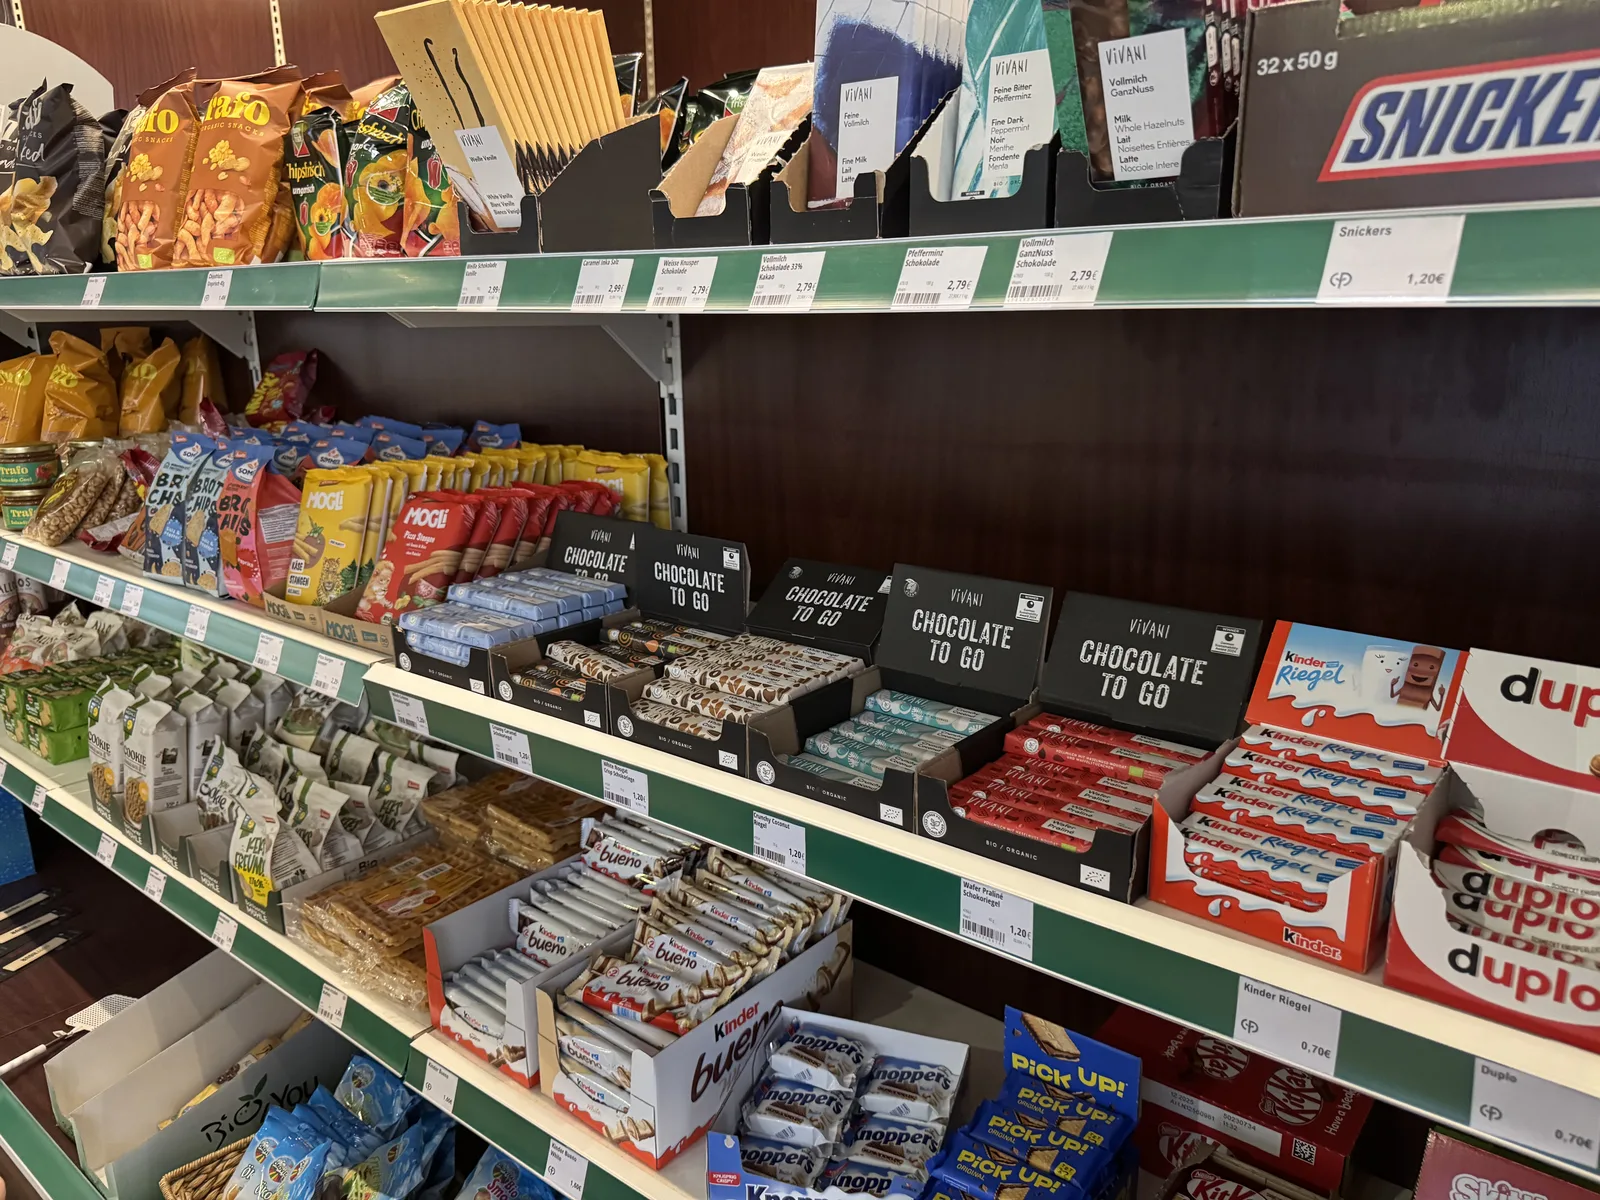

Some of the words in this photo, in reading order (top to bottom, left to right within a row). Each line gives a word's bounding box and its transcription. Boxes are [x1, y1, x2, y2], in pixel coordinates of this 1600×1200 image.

[993, 86, 1012, 94] Feine
[1013, 83, 1033, 92] Bitter
[1109, 74, 1148, 87] Vollmilch
[993, 93, 1032, 103] Pfefferminz
[1110, 84, 1154, 97] GanzNuss
[843, 119, 870, 128] Vollmilch
[844, 112, 860, 120] Feine
[991, 117, 1006, 126] Fine
[1006, 115, 1024, 124] Dark
[1113, 114, 1132, 124] Milk
[1342, 67, 1600, 164] SNICKE
[990, 124, 1030, 135] Peppermint
[1114, 123, 1142, 133] Whole
[1143, 117, 1186, 130] Hazelnuts
[989, 144, 1014, 152] Menthe
[990, 136, 1005, 144] Noir
[1116, 135, 1131, 144] Lait
[1117, 143, 1156, 154] Noisettes
[1156, 138, 1191, 149] Entières
[842, 157, 854, 165] Fine
[988, 153, 1020, 162] Fondente
[1118, 154, 1139, 164] Latte
[987, 162, 1009, 171] Menta
[1120, 162, 1154, 173] Nocciole
[1155, 160, 1180, 170] Intere
[1338, 224, 1392, 238] Snickers
[1021, 237, 1055, 248] Vollmilch
[763, 255, 788, 263] Vollmilch
[907, 248, 944, 257] Pfefferminz
[1018, 249, 1053, 259] GanzNuss
[663, 259, 680, 267] Weisse
[679, 259, 700, 267] Knusper
[760, 264, 790, 272] Schokolade
[905, 258, 940, 267] Schokolade
[1016, 258, 1057, 268] Schokolade
[758, 273, 775, 281] Kakao
[1069, 270, 1099, 281] 2,79€
[1406, 272, 1446, 286] 1,20€
[946, 280, 972, 291] 2,79€
[563, 546, 628, 573] CHOCOLATE
[654, 561, 725, 594] CHOCOLATE
[669, 586, 686, 606] TO
[692, 591, 710, 612] GO
[785, 585, 874, 612] CHOCOLATE
[792, 605, 815, 622] TO
[816, 609, 842, 627] GO
[911, 608, 1014, 650] CHOCOLATE
[930, 638, 952, 664] TO
[959, 645, 986, 672] GO
[1079, 639, 1208, 686] CHOCOLATE
[1284, 650, 1327, 669] Kinder
[1275, 663, 1346, 694] Riegel
[1100, 672, 1128, 700] TO
[1138, 680, 1171, 709] GO
[88, 730, 111, 754] COOKIE
[671, 739, 693, 750] ORGANIC
[1259, 728, 1323, 749] Kinder
[1321, 742, 1387, 763] Riegel
[123, 744, 147, 767] COOKIE
[603, 761, 614, 770] White
[1240, 750, 1304, 774] Kinder
[1301, 767, 1369, 789] Riegel
[1066, 806, 1094, 819] Praliné
[1069, 803, 1095, 814] Wafer
[1291, 794, 1359, 816] Riegel
[753, 812, 772, 825] Crunchy
[771, 817, 790, 830] Coconut
[753, 819, 768, 829] Riegel
[1052, 818, 1077, 831] Wafer
[1276, 805, 1345, 828] Riegel
[1047, 823, 1075, 835] Praliné
[1196, 815, 1263, 841] Kinder
[1260, 835, 1331, 860] Riegel
[599, 845, 642, 868] bueno
[788, 846, 805, 861] 1,20€
[985, 839, 997, 848] BIO
[1006, 845, 1038, 861] ORGANIC
[358, 859, 378, 873] Bio
[1241, 848, 1312, 875] Riegel
[744, 877, 764, 894] Kinder
[962, 881, 981, 893] Wafer
[982, 885, 1004, 901] Praliné
[962, 889, 1001, 909] Schokoriegel
[685, 926, 706, 943] Kinder
[1009, 924, 1032, 941] 1,20€
[527, 930, 567, 956] bueno
[669, 937, 689, 956] Kinder
[1283, 927, 1342, 960] Kinder
[655, 942, 697, 970] bueno
[615, 969, 670, 992] bueno
[637, 965, 661, 980] Kinder
[1447, 942, 1600, 1012] duplo
[1243, 981, 1277, 1003] Kinder
[1278, 991, 1313, 1014] Riegel
[714, 1001, 760, 1043] Kinder
[1300, 1041, 1332, 1059] 0,70€
[1077, 1065, 1127, 1098] UP!
[1480, 1063, 1518, 1083] Duplo
[1017, 1099, 1045, 1115] ORIGINAL
[1075, 1102, 1116, 1125] UP!
[987, 1127, 1016, 1144] ORIGINAL
[1324, 1119, 1341, 1136] Have
[1047, 1130, 1090, 1156] UP!
[1554, 1128, 1595, 1150] 0,70€
[550, 1150, 562, 1161] White
[551, 1142, 565, 1154] Kinder
[564, 1150, 578, 1162] Bueno
[956, 1162, 985, 1182] ORIGINAL
[1018, 1166, 1063, 1193] UP!
